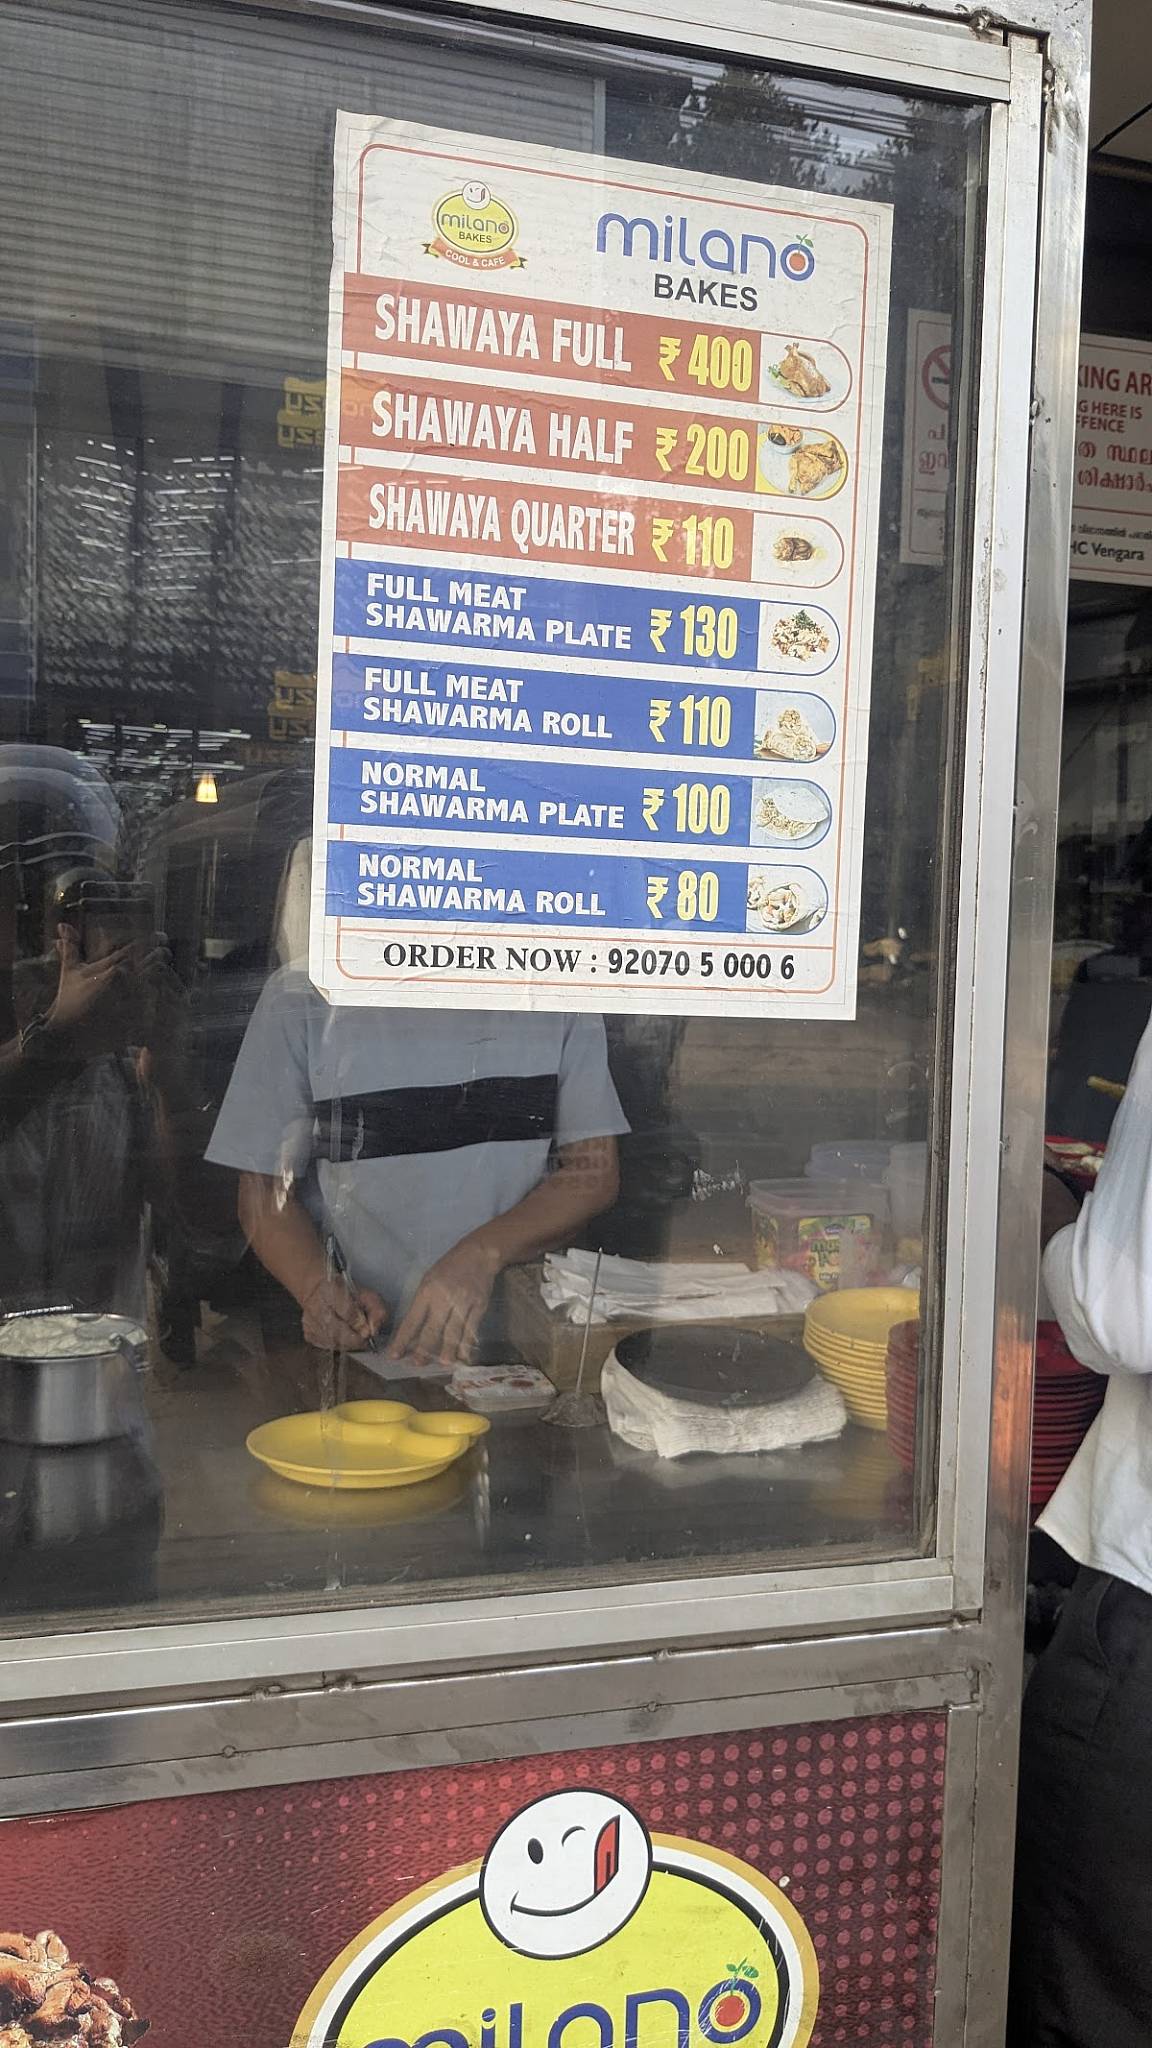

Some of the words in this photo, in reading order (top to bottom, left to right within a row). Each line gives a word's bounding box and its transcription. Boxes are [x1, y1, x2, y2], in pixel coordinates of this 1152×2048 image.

[441, 213, 510, 234] milano
[458, 231, 492, 243] BAKES
[445, 249, 471, 265] COOL
[472, 258, 480, 267] &
[481, 256, 505, 267] CAFE
[596, 212, 815, 281] milano
[654, 274, 759, 312] BAKES
[375, 293, 539, 360] SHAWAYA
[553, 319, 632, 372] FULL
[372, 391, 536, 455] SHAWAYA
[549, 412, 634, 465] HALF
[1092, 401, 1127, 418] HERE
[1130, 405, 1143, 419] IS
[369, 483, 501, 542] SHAWAYA
[511, 499, 635, 556] QUARTER
[1091, 542, 1144, 563] Vengara
[367, 572, 439, 603] FULL
[449, 579, 526, 610] MEAT
[366, 603, 535, 641] SHAWARMA
[546, 619, 631, 650] PLATE
[364, 666, 435, 696] FULL
[446, 673, 523, 702] MEAT
[363, 696, 532, 733] SHAWARMA
[543, 713, 612, 738] ROLL
[361, 761, 486, 793] NORMAL
[360, 791, 528, 825] SHAWARMA
[539, 802, 624, 829] PLATE
[359, 853, 482, 883] NORMAL
[358, 883, 525, 913] SHAWARMA
[536, 891, 605, 916] ROLL
[383, 942, 496, 970] ORDER
[506, 949, 581, 973] NOW
[608, 949, 690, 977] 92070
[364, 1978, 761, 2048] ilano
